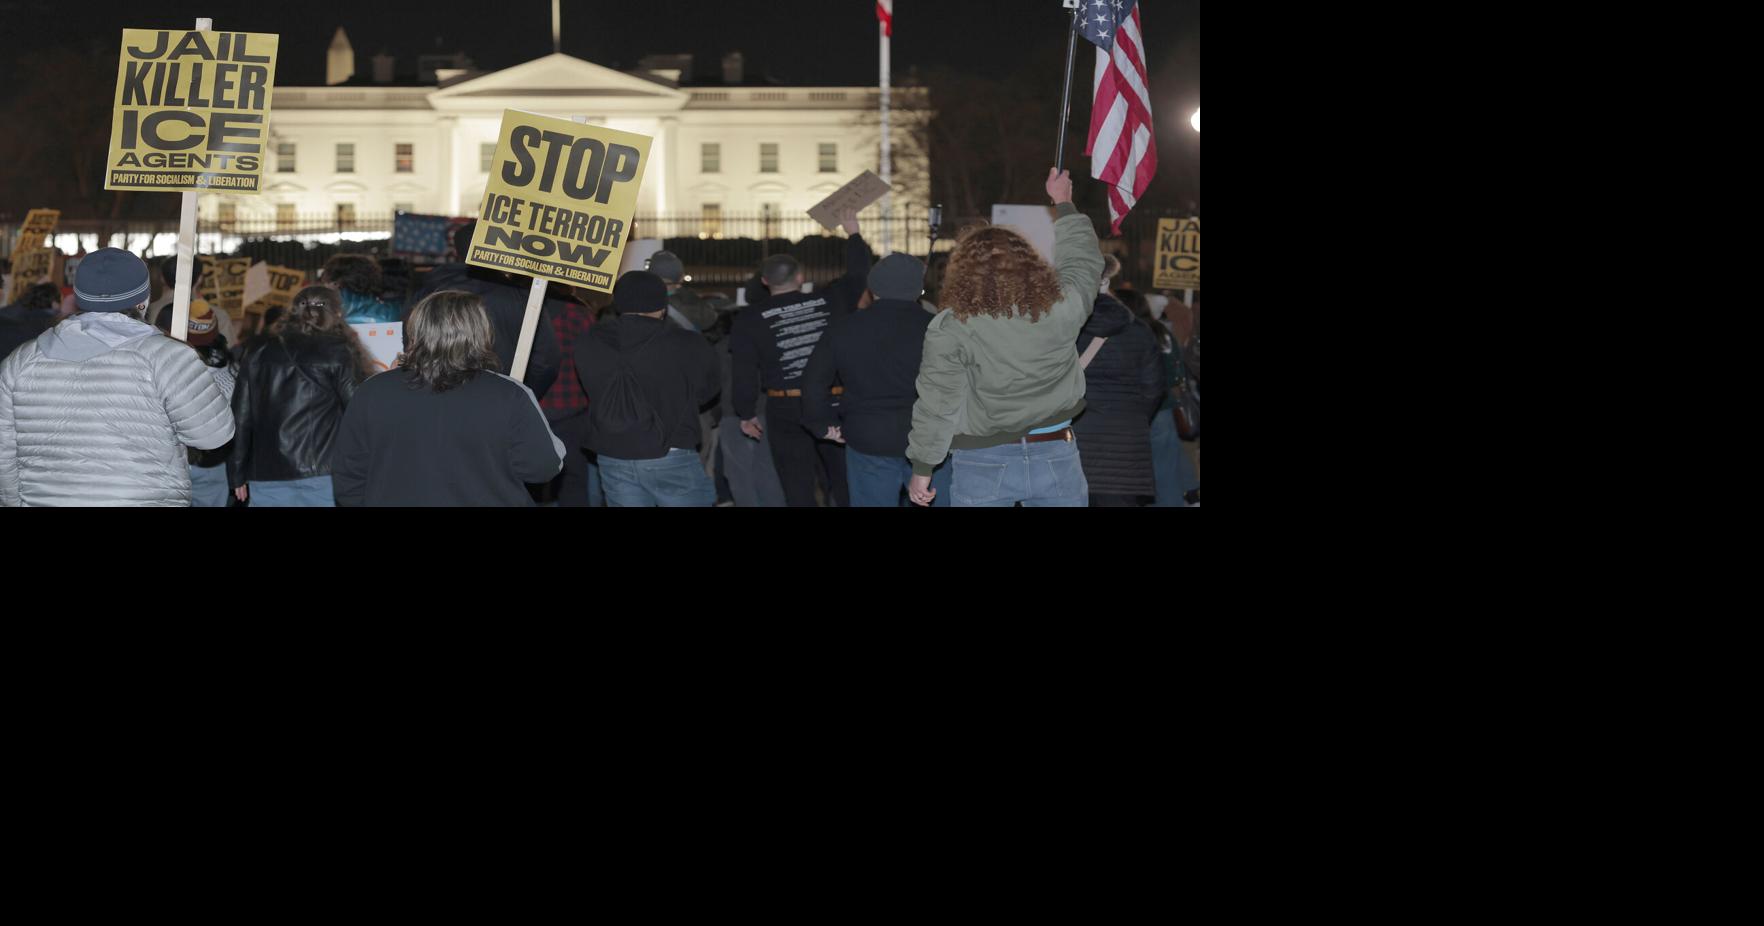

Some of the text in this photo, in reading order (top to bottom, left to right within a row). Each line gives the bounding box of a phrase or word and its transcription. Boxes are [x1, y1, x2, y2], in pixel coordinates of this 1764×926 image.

[127, 31, 270, 63] JAIL
[121, 61, 268, 110] KILLER
[120, 110, 263, 153] ICE
[113, 173, 255, 188] PARTY FOR SOCIALISM & LIBERATION
[116, 152, 259, 171] AGENTS
[501, 125, 640, 204] STOP
[483, 192, 624, 248] ICE TERROR
[484, 225, 611, 267] NOW
[268, 268, 300, 291] TOP
[473, 250, 609, 286] PARTY FOR SOCIALISM & LIBERATION
